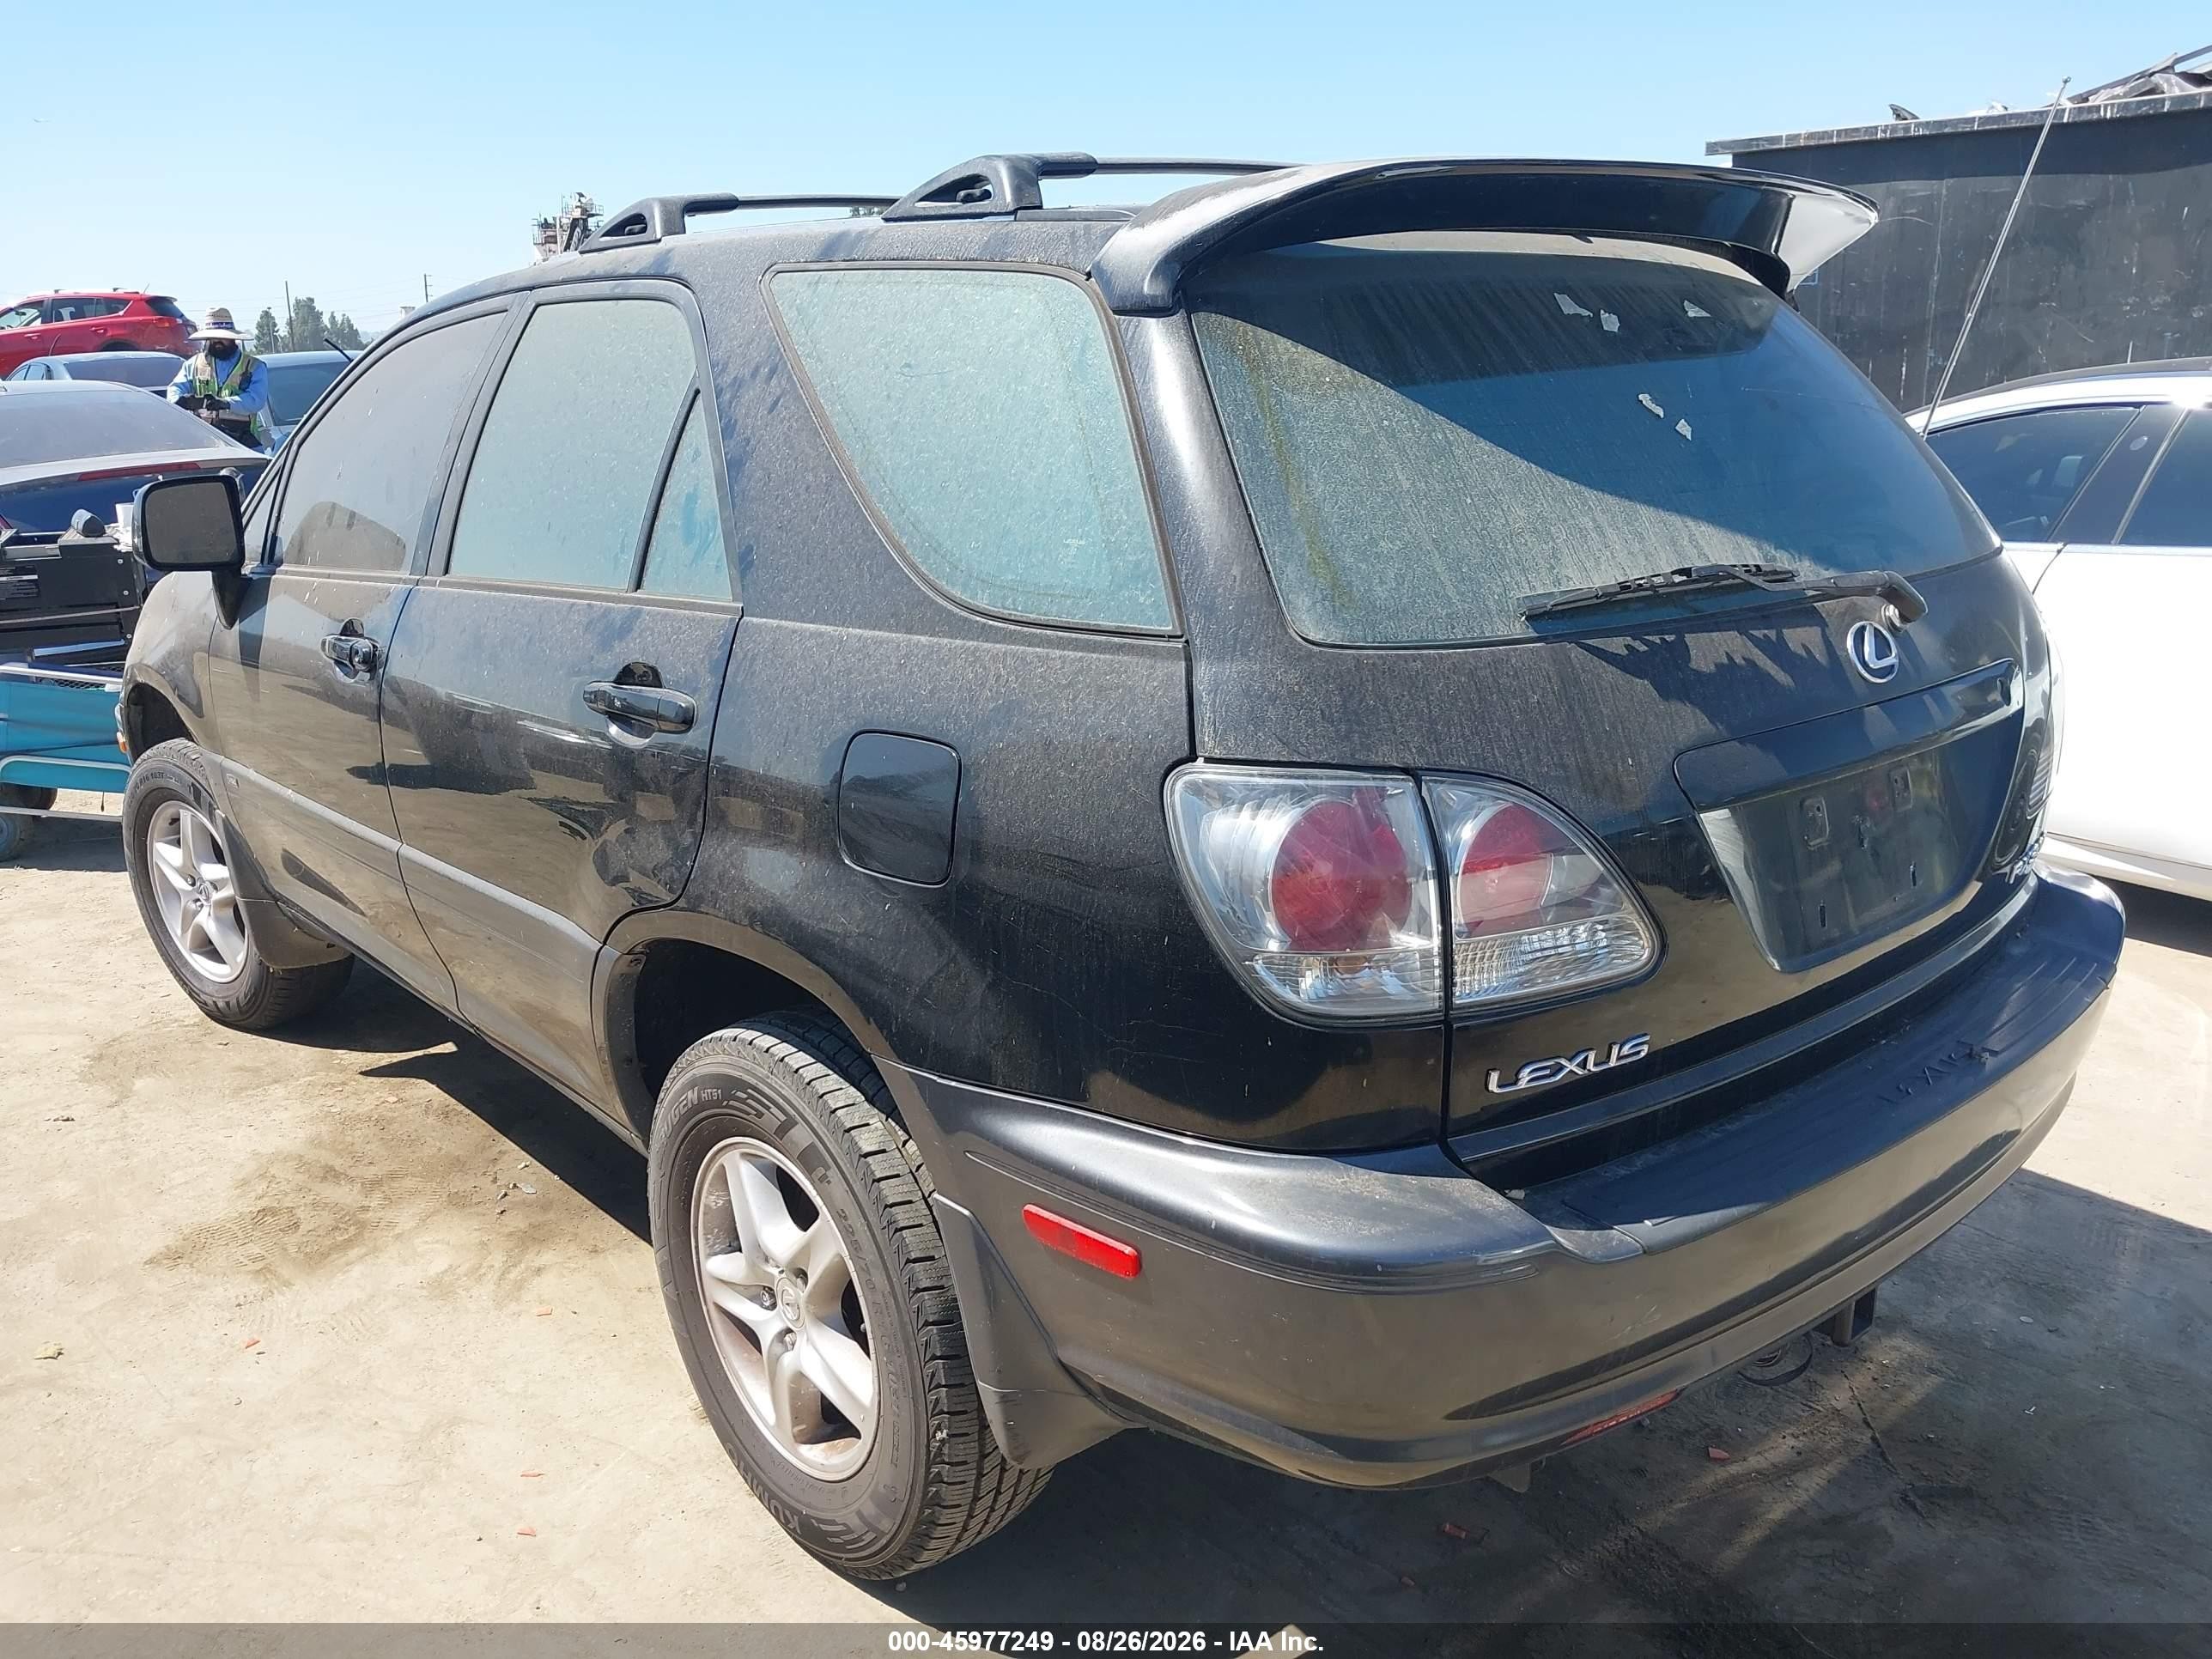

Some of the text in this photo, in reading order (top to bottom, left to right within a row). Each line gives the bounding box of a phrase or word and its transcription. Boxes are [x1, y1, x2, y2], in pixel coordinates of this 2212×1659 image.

[1485, 1033, 1650, 1093] LEXUS
[700, 1089, 722, 1101] HT51
[726, 1443, 802, 1534] KUMHO
